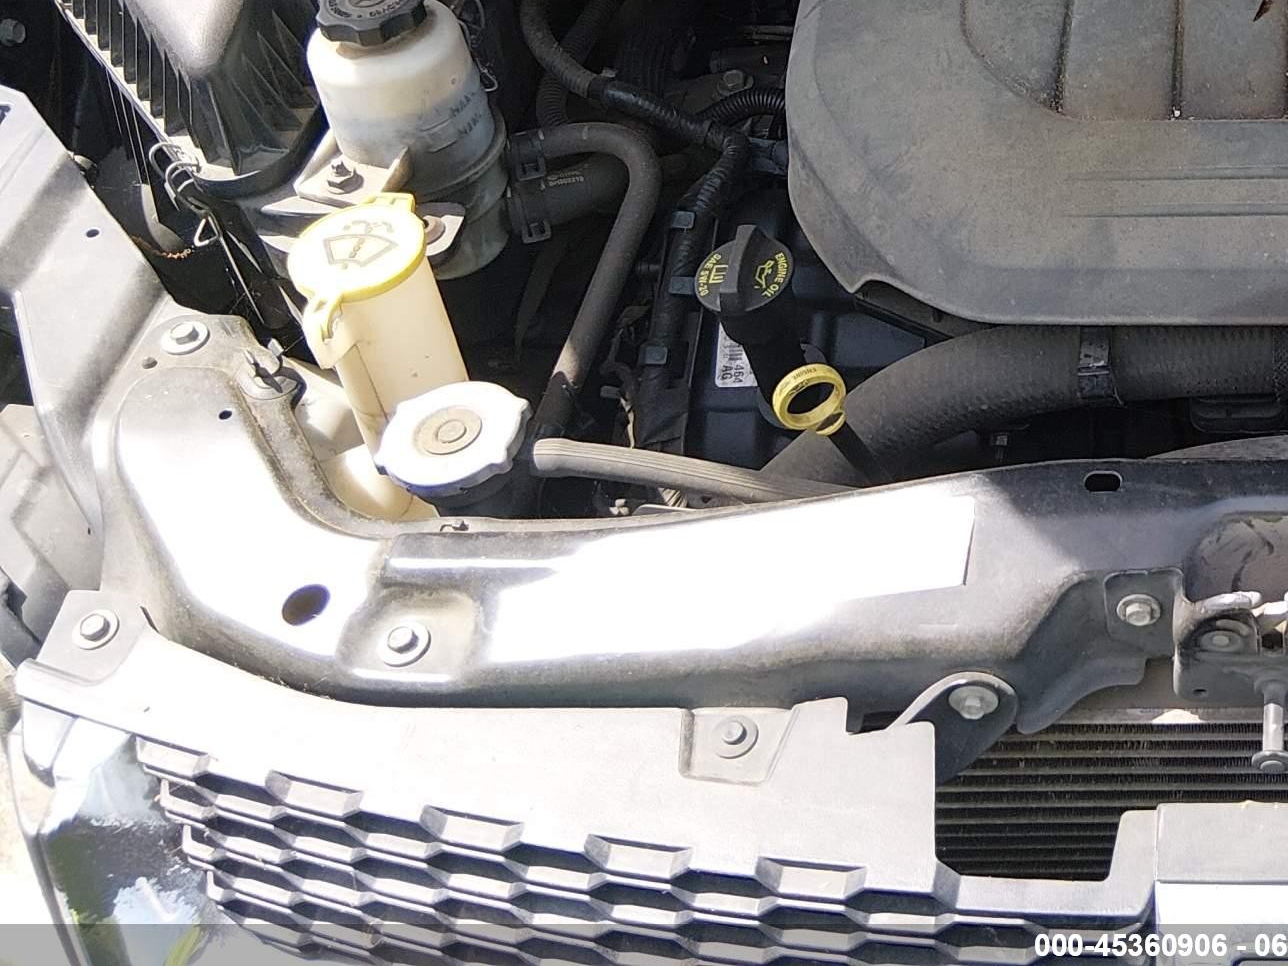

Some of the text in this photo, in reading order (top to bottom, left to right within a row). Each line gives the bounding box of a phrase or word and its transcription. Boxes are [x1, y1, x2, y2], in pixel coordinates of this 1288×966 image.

[698, 253, 721, 297] SAE 5W-20
[761, 252, 788, 298] ENGINE OIL
